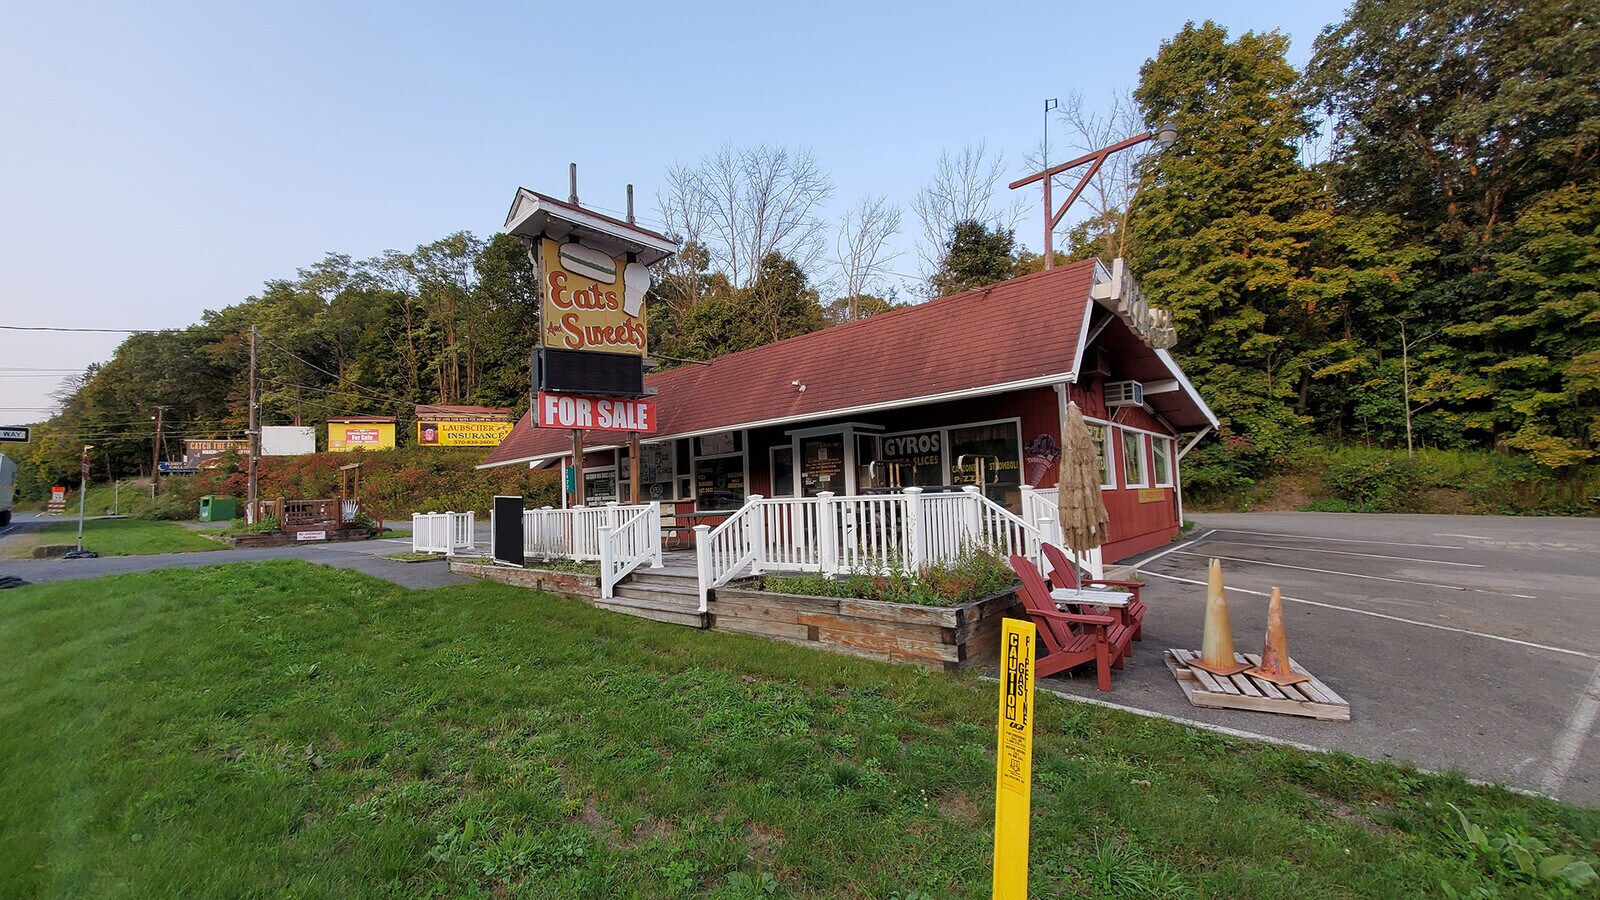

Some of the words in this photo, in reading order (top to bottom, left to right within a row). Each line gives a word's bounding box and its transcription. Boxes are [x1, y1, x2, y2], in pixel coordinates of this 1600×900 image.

[547, 271, 619, 311] Eats
[560, 313, 646, 351] Sweets
[545, 395, 592, 427] FOR
[597, 400, 648, 430] SALE
[190, 442, 212, 450] CATCH
[213, 442, 226, 450] THE
[885, 434, 940, 456] GYROS
[913, 456, 939, 466] SLICES
[952, 464, 977, 473] CAZONE
[954, 475, 983, 484] PZZ
[1006, 633, 1018, 721] CAUTION
[1009, 722, 1025, 731] UGI
